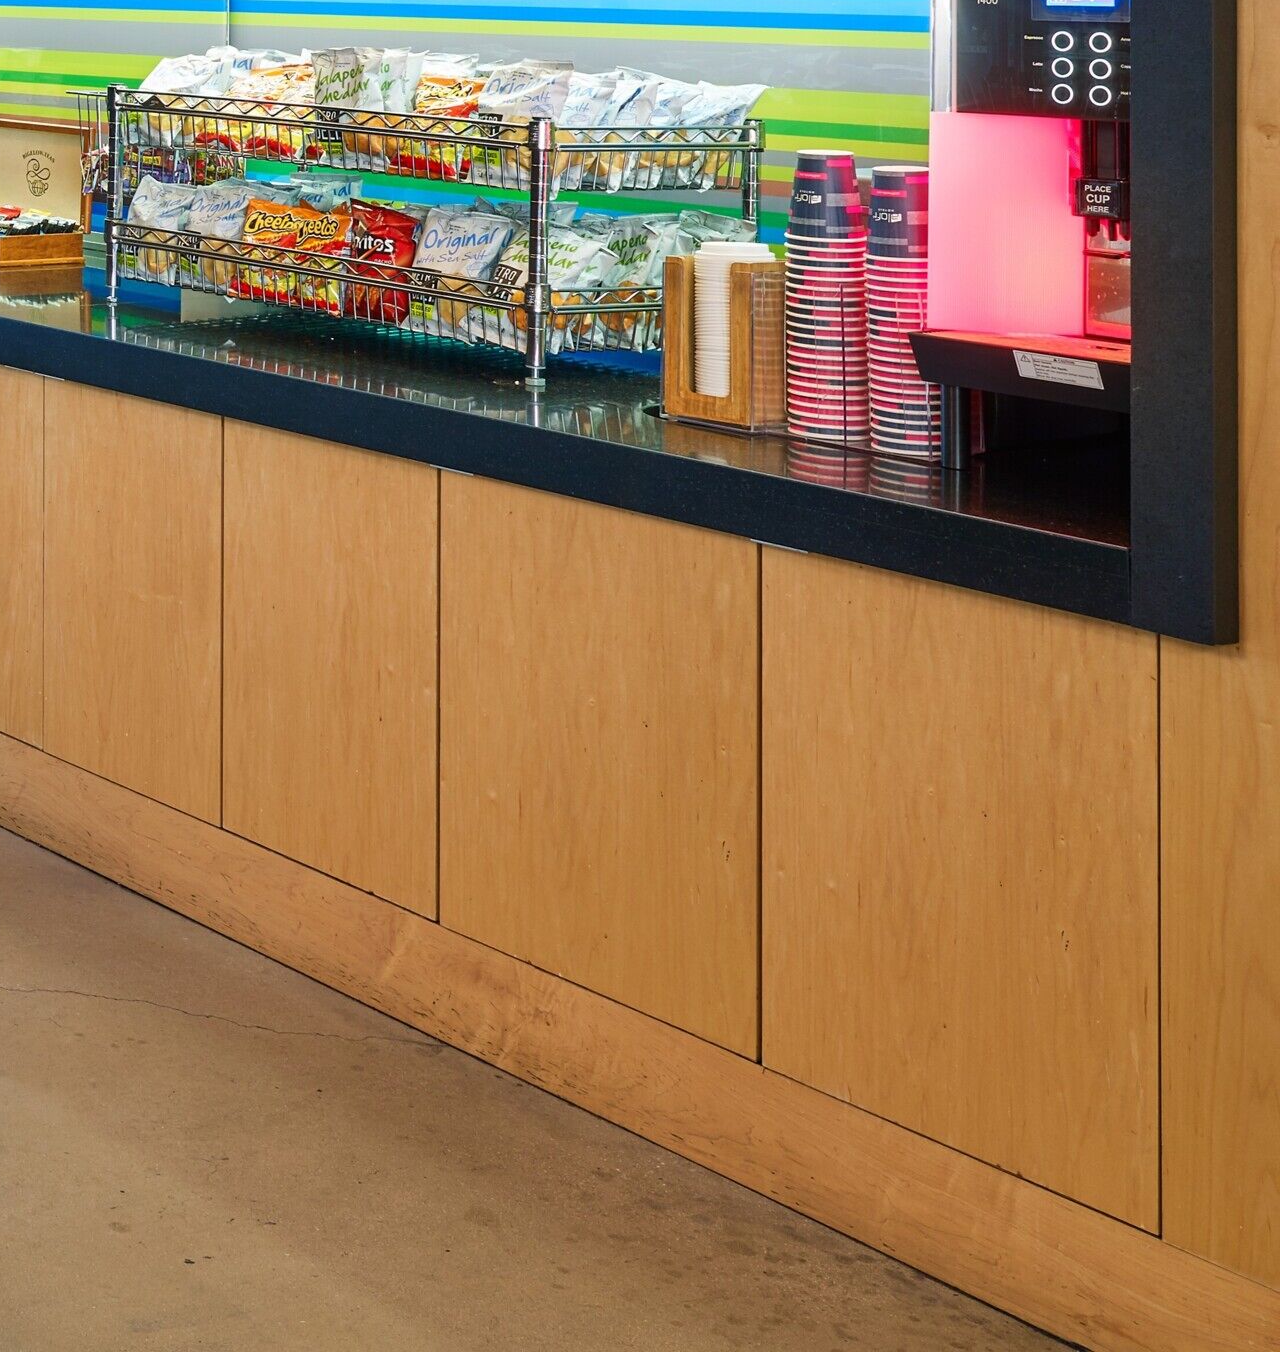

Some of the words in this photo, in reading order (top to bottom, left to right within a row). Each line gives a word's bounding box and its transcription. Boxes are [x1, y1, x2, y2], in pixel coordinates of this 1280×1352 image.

[1084, 184, 1112, 193] PLACE
[1086, 194, 1110, 204] CUP
[1086, 205, 1110, 213] HERE
[424, 227, 499, 256] Original
[416, 254, 435, 265] with
[439, 253, 461, 263] Sea
[464, 251, 488, 261] Salt
